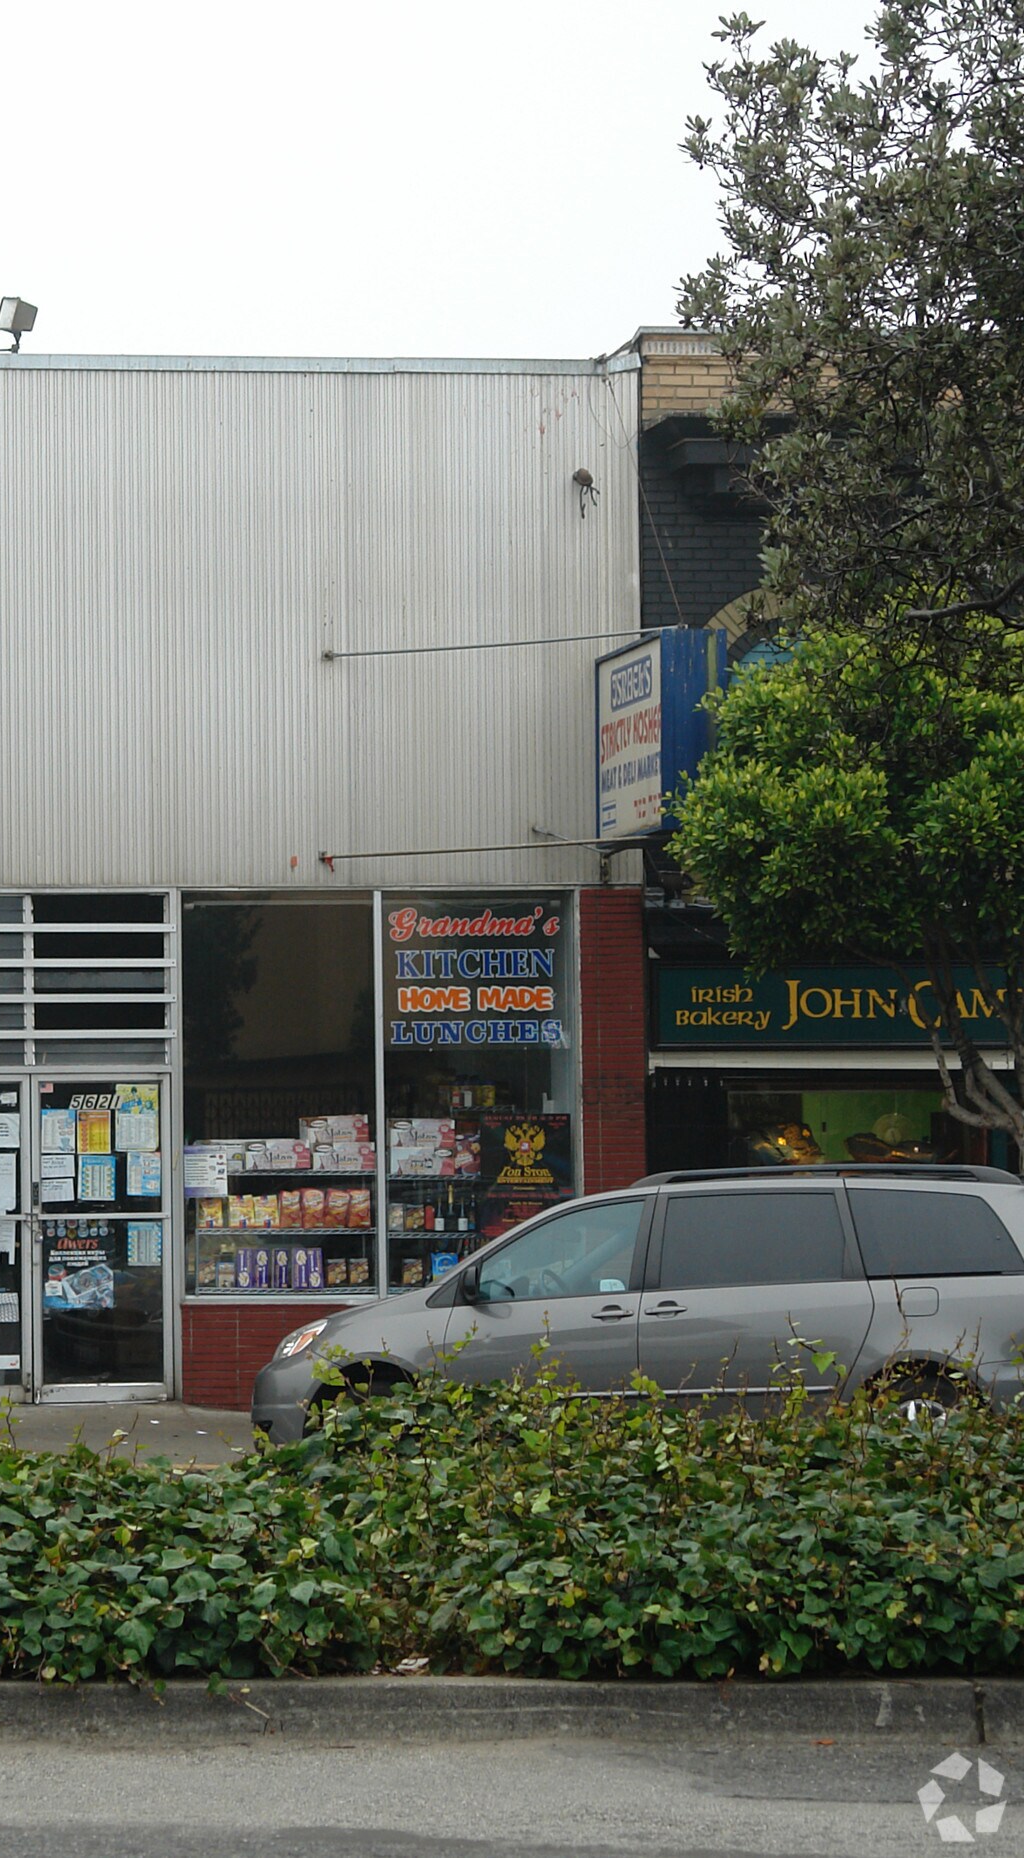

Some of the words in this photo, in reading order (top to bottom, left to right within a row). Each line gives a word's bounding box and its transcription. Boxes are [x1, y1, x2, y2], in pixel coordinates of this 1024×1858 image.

[601, 716, 632, 765] STRICTLY
[601, 765, 617, 793] MEAT
[388, 906, 560, 942] Grandma's
[395, 949, 555, 980] KITCHEN
[398, 986, 471, 1013] HOME
[477, 986, 554, 1013] MADE
[391, 1020, 561, 1045] LUNCHES
[70, 1095, 121, 1109] 5621
